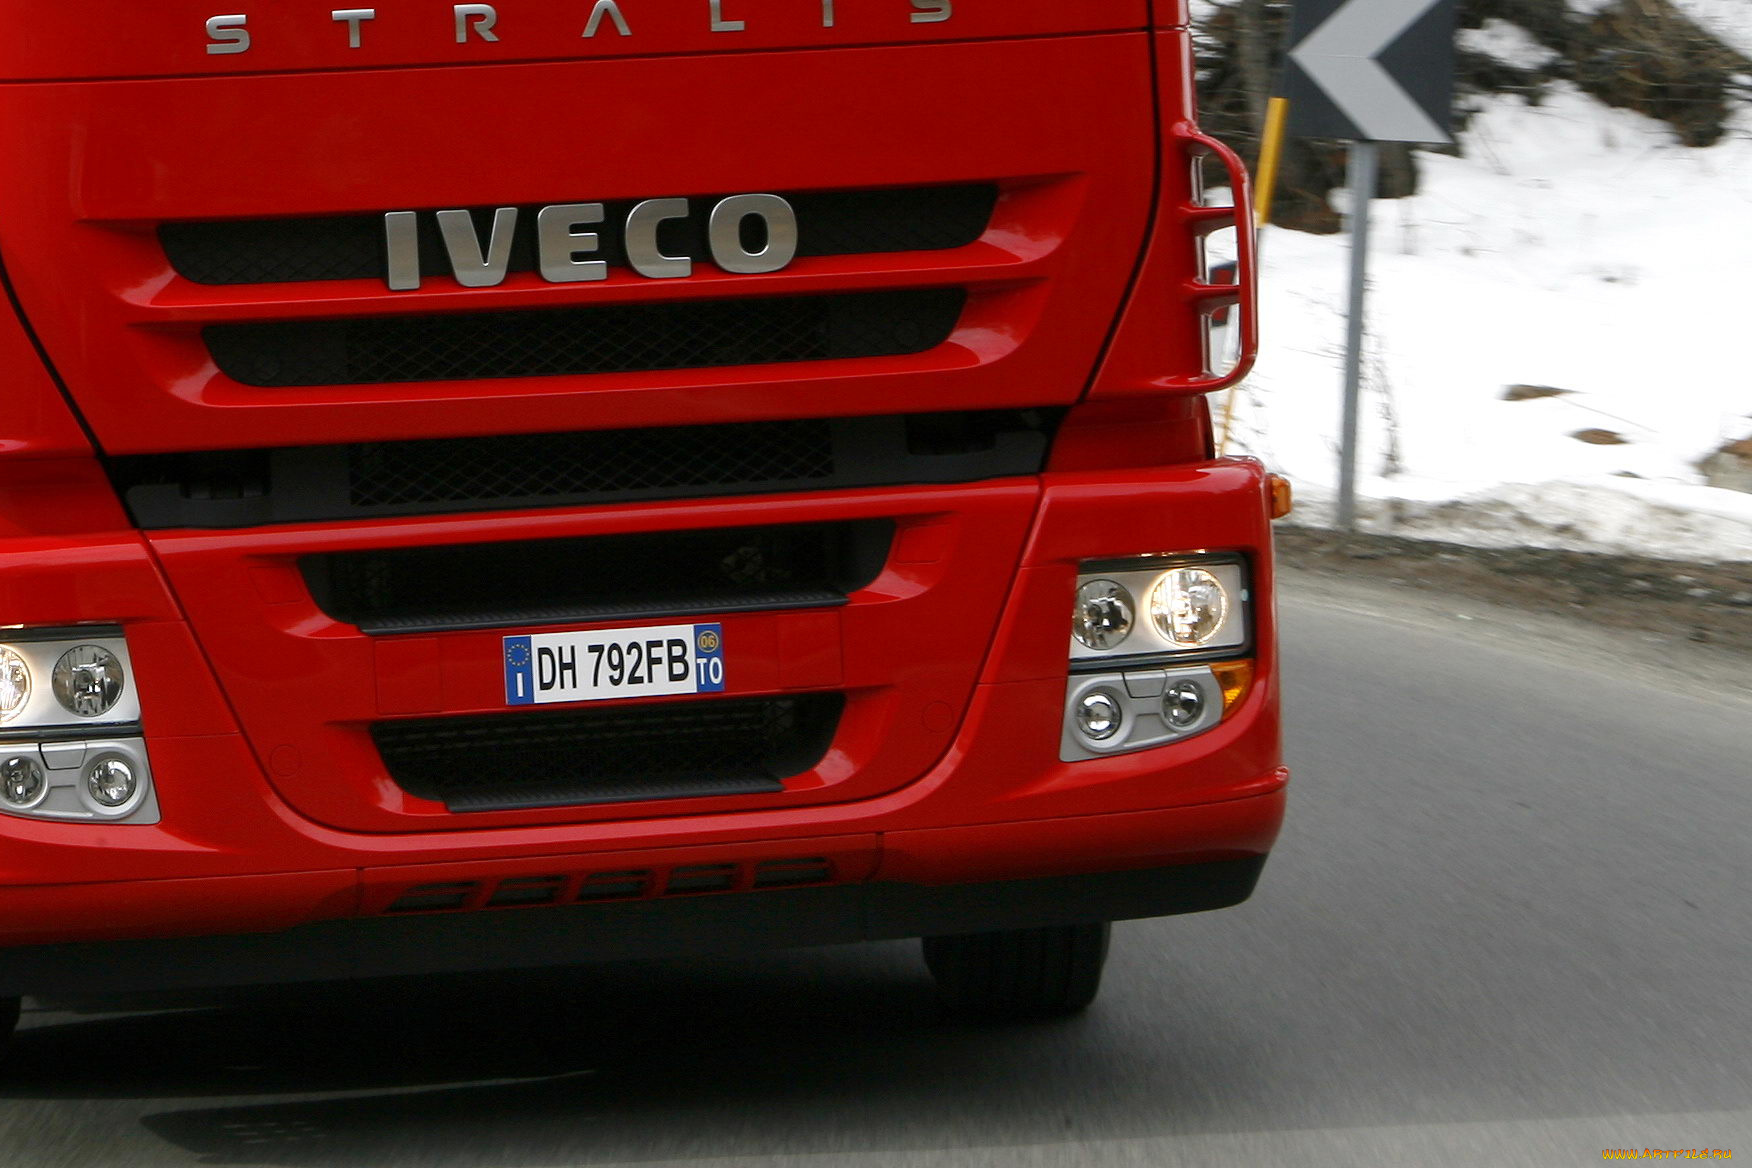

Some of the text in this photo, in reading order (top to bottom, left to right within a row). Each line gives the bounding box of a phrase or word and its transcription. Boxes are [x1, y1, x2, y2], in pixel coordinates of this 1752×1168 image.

[384, 193, 799, 291] IVECO
[537, 644, 577, 691] DH
[587, 638, 690, 688] 792FB
[696, 656, 724, 686] TO
